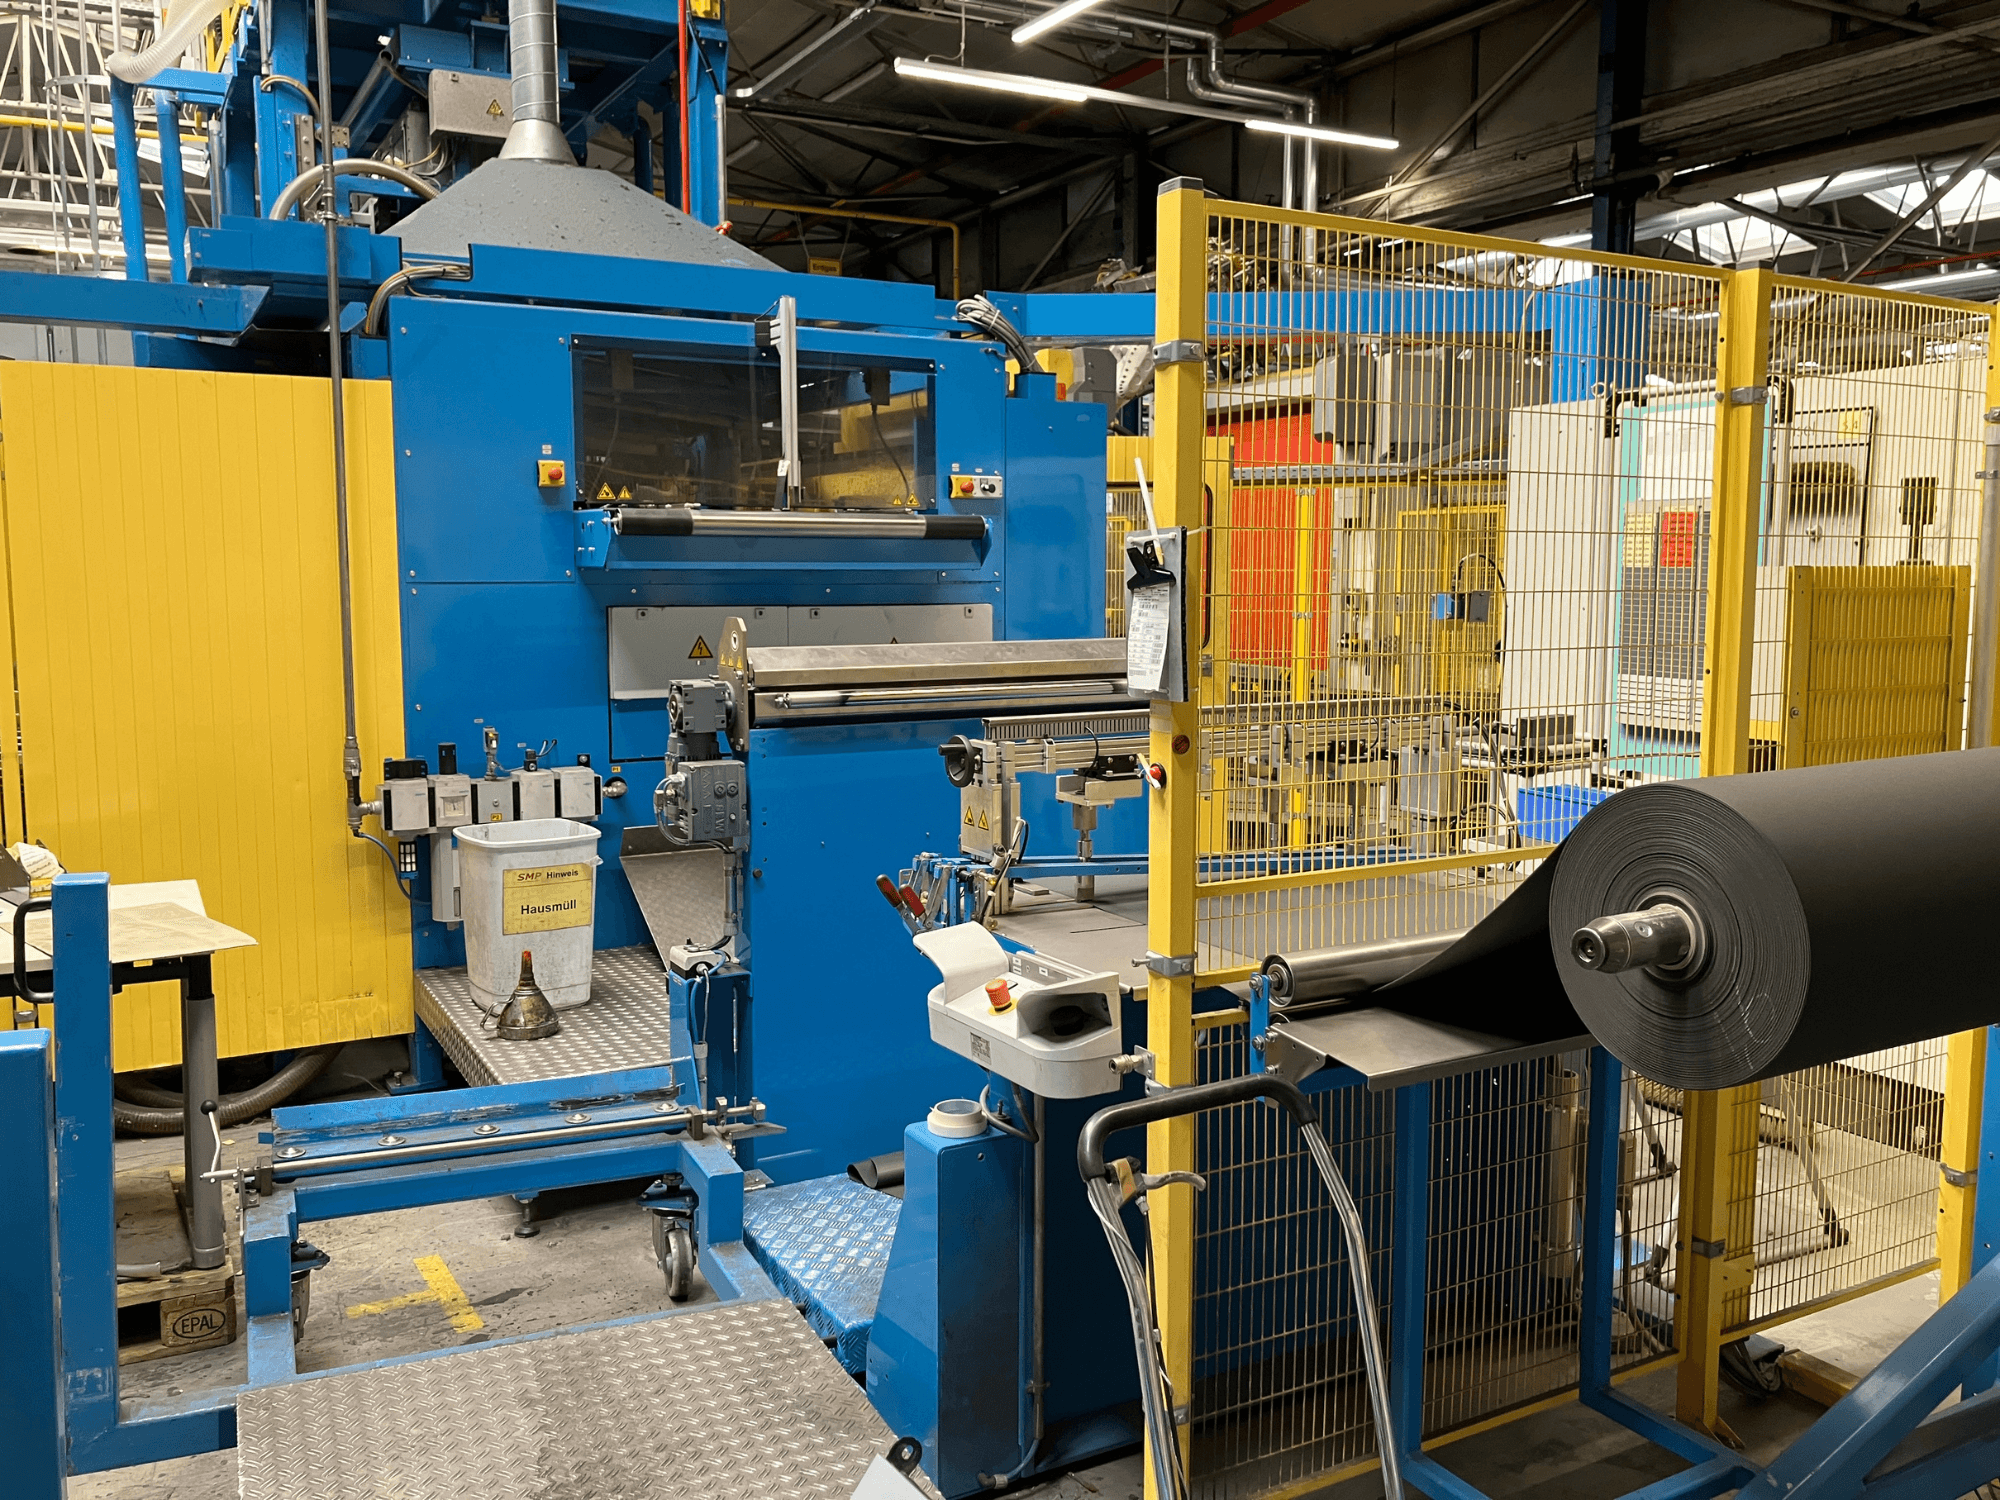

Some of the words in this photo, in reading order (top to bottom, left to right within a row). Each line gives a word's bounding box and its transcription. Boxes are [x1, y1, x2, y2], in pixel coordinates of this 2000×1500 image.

[517, 872, 542, 881] SMP
[546, 869, 579, 879] Hinweis
[521, 899, 577, 915] Hausmüll
[182, 1314, 219, 1334] EPAL
